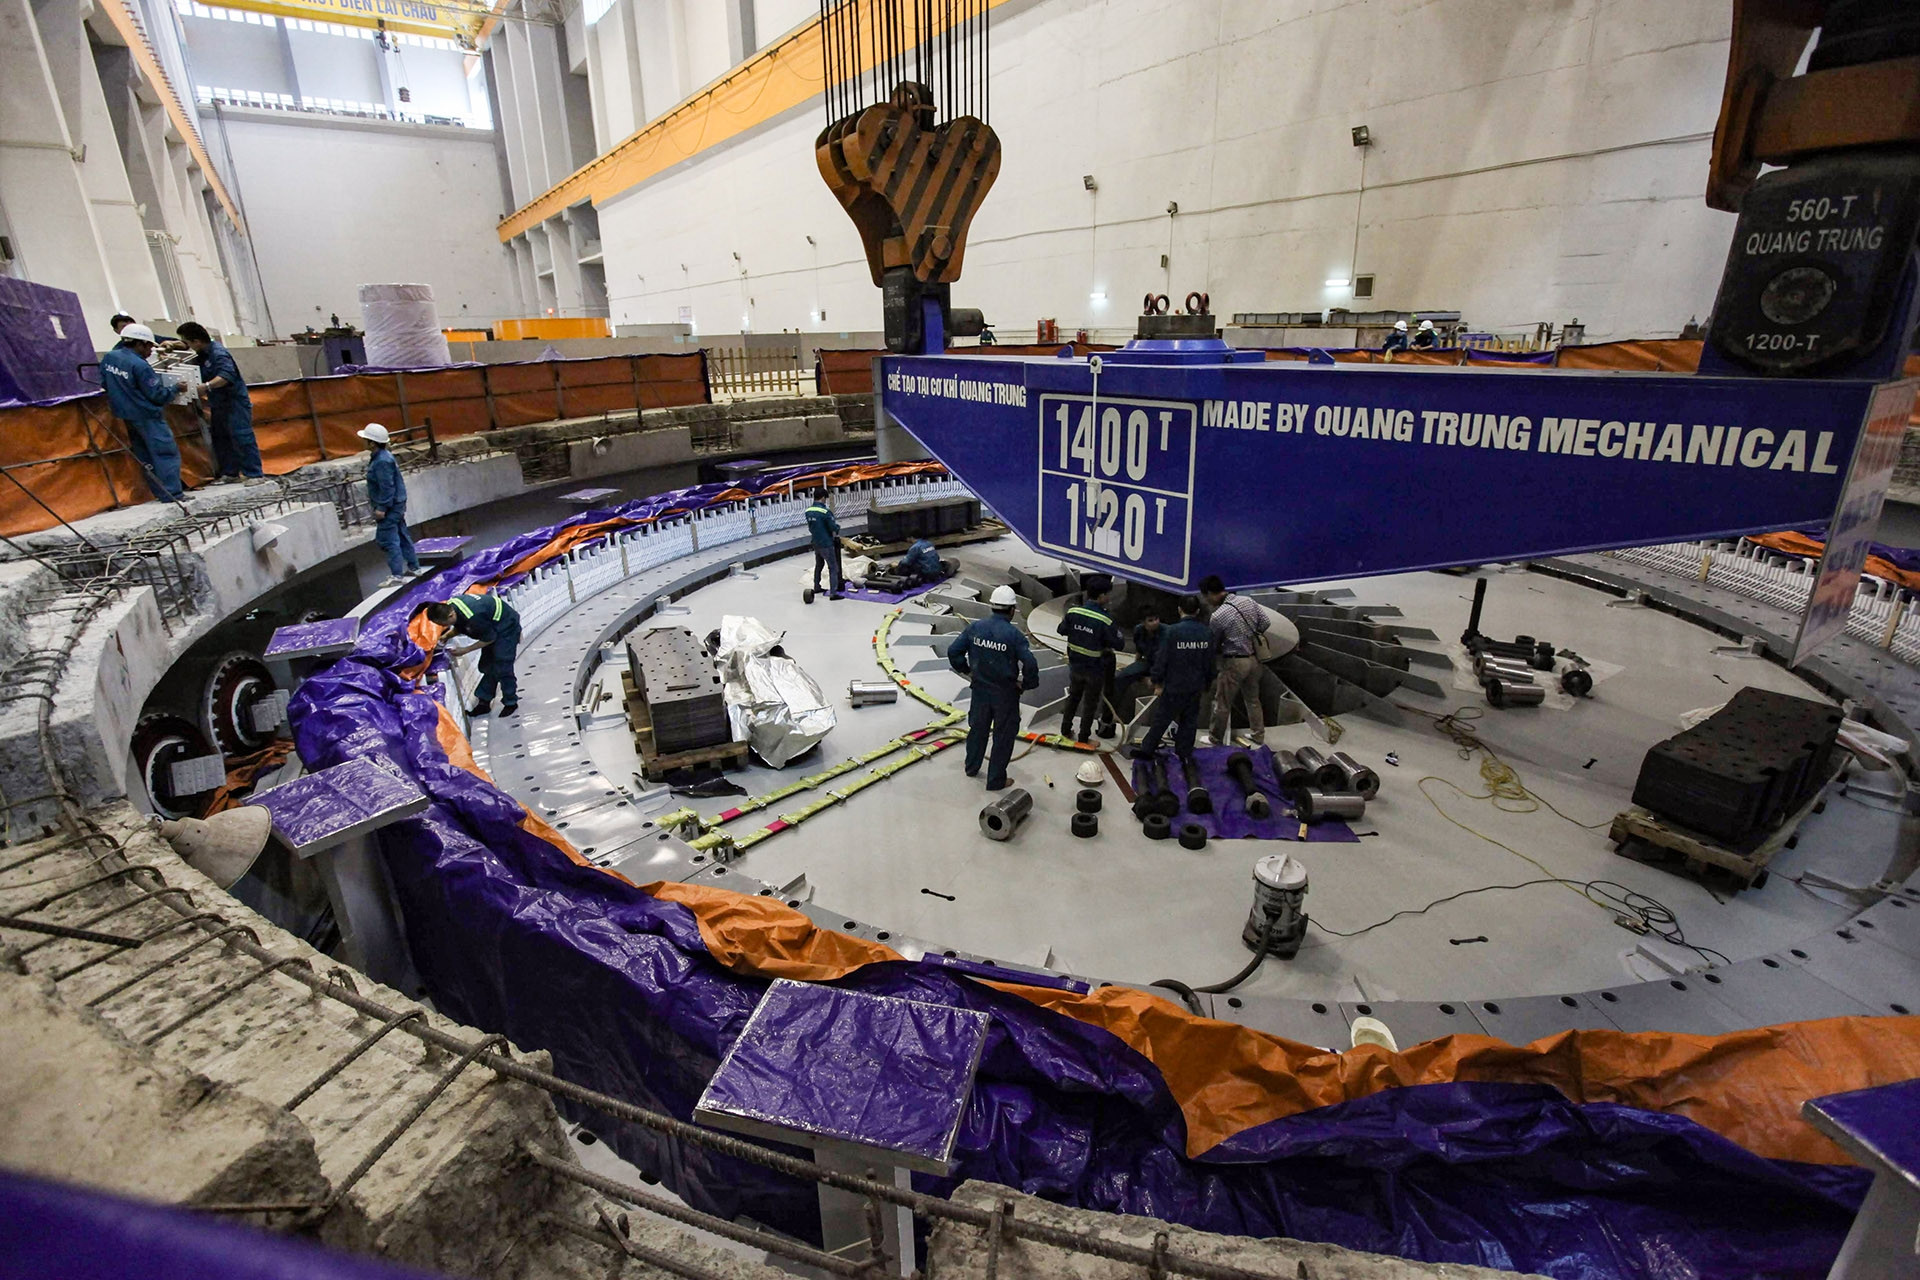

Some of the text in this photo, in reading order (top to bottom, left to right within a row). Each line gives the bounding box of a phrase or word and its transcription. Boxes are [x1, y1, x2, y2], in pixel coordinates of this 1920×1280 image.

[1786, 195, 1858, 222] 560-T
[1746, 226, 1884, 255] QUANG TRUNG
[1746, 334, 1820, 350] 1200-T
[887, 366, 1026, 408] CHẾ TẠO TẠI CƠ KHÍ QUANG TRUNG
[1056, 403, 1173, 481] 1400 T
[1202, 400, 1838, 474] MADE BY QUANG TRUNG MECHANICAL
[1155, 498, 1167, 534] T
[973, 637, 1007, 652] LILAMA10
